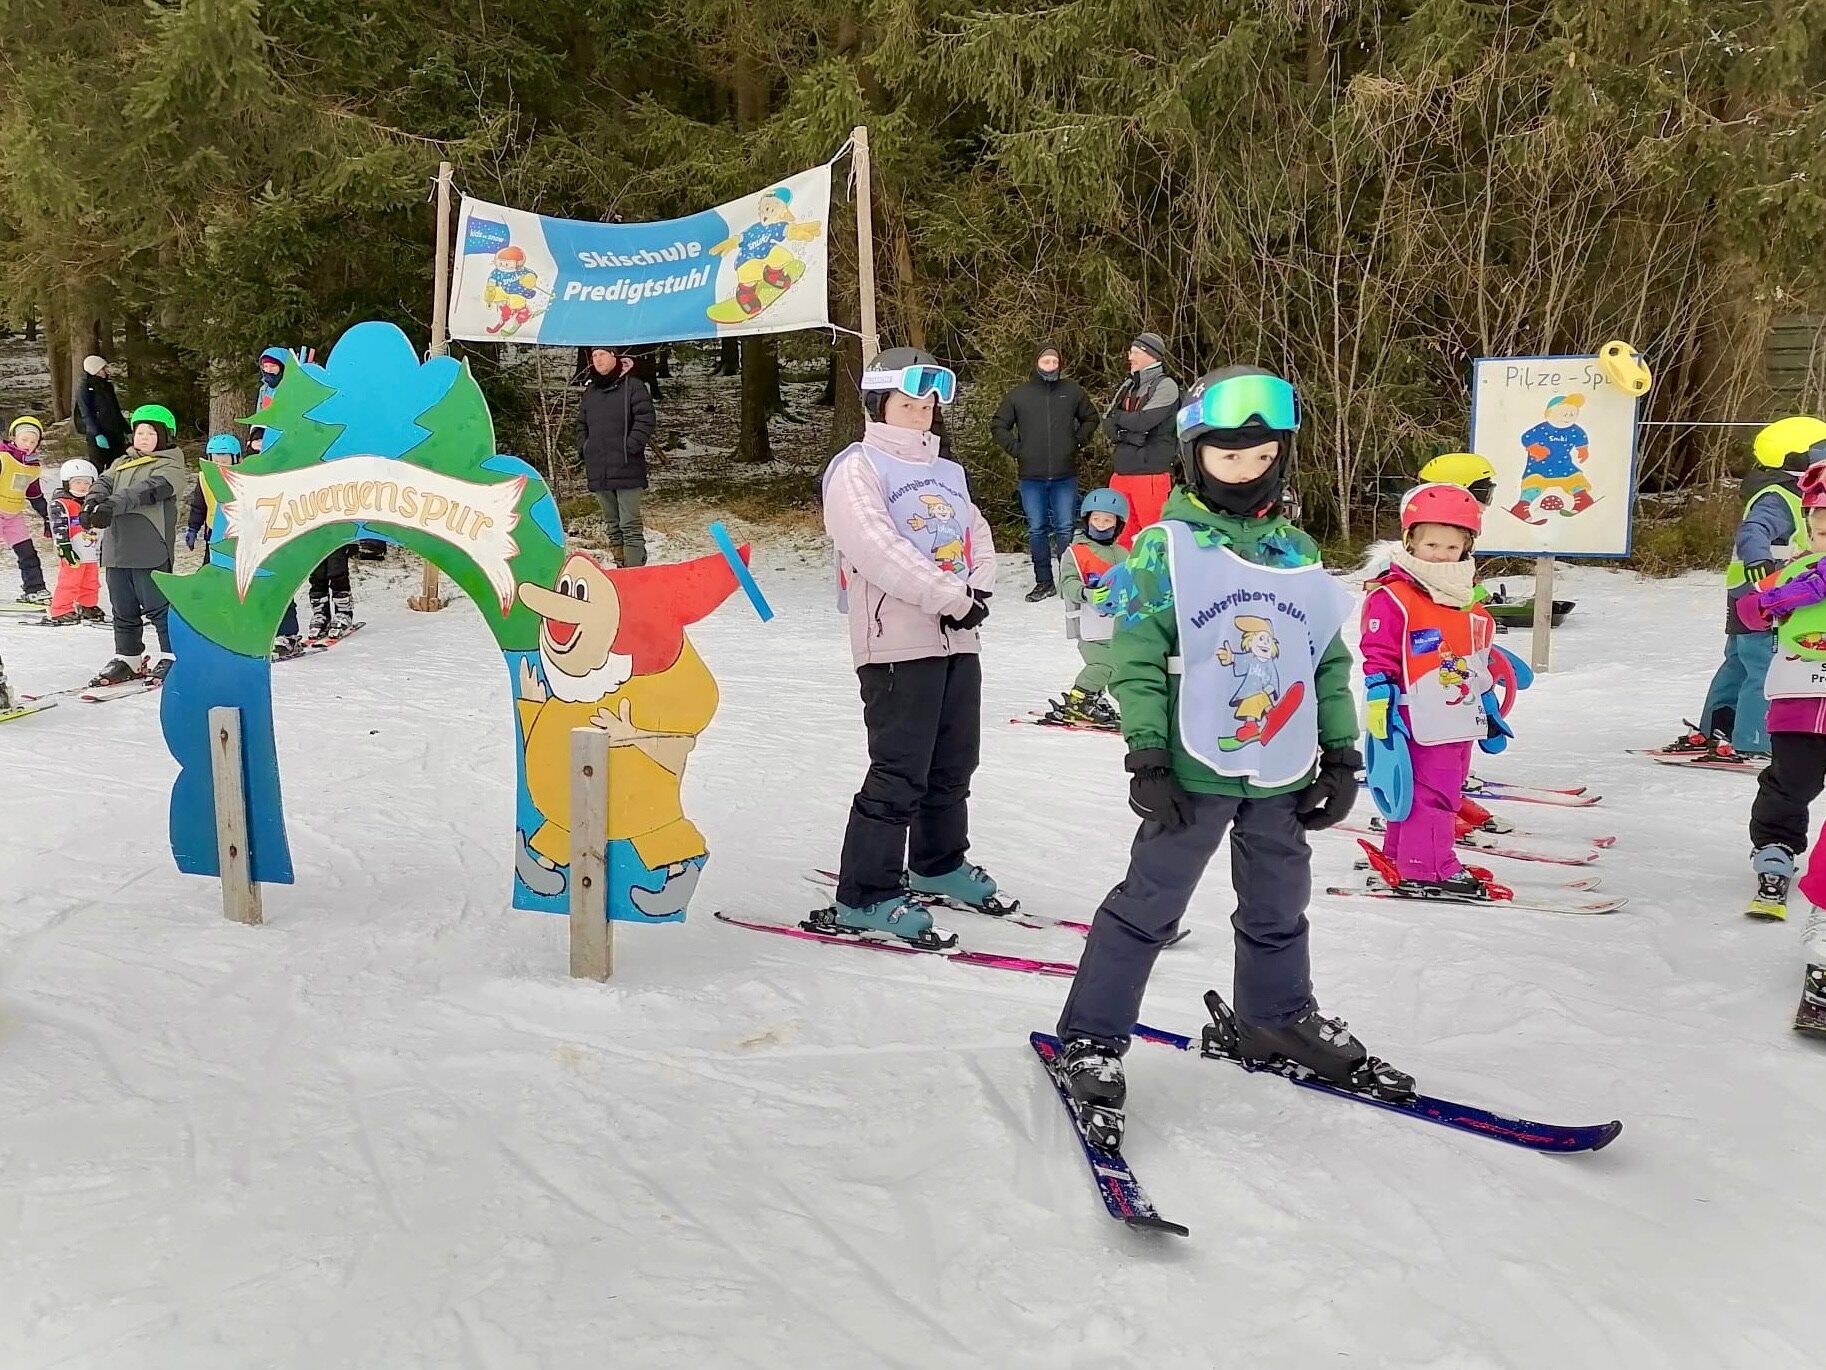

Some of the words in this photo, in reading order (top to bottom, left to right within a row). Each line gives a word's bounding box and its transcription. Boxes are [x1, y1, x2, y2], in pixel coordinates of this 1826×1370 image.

[578, 241, 702, 268] Skischule
[563, 264, 711, 305] Predigtstuhl
[256, 480, 494, 544] Zwergenspur
